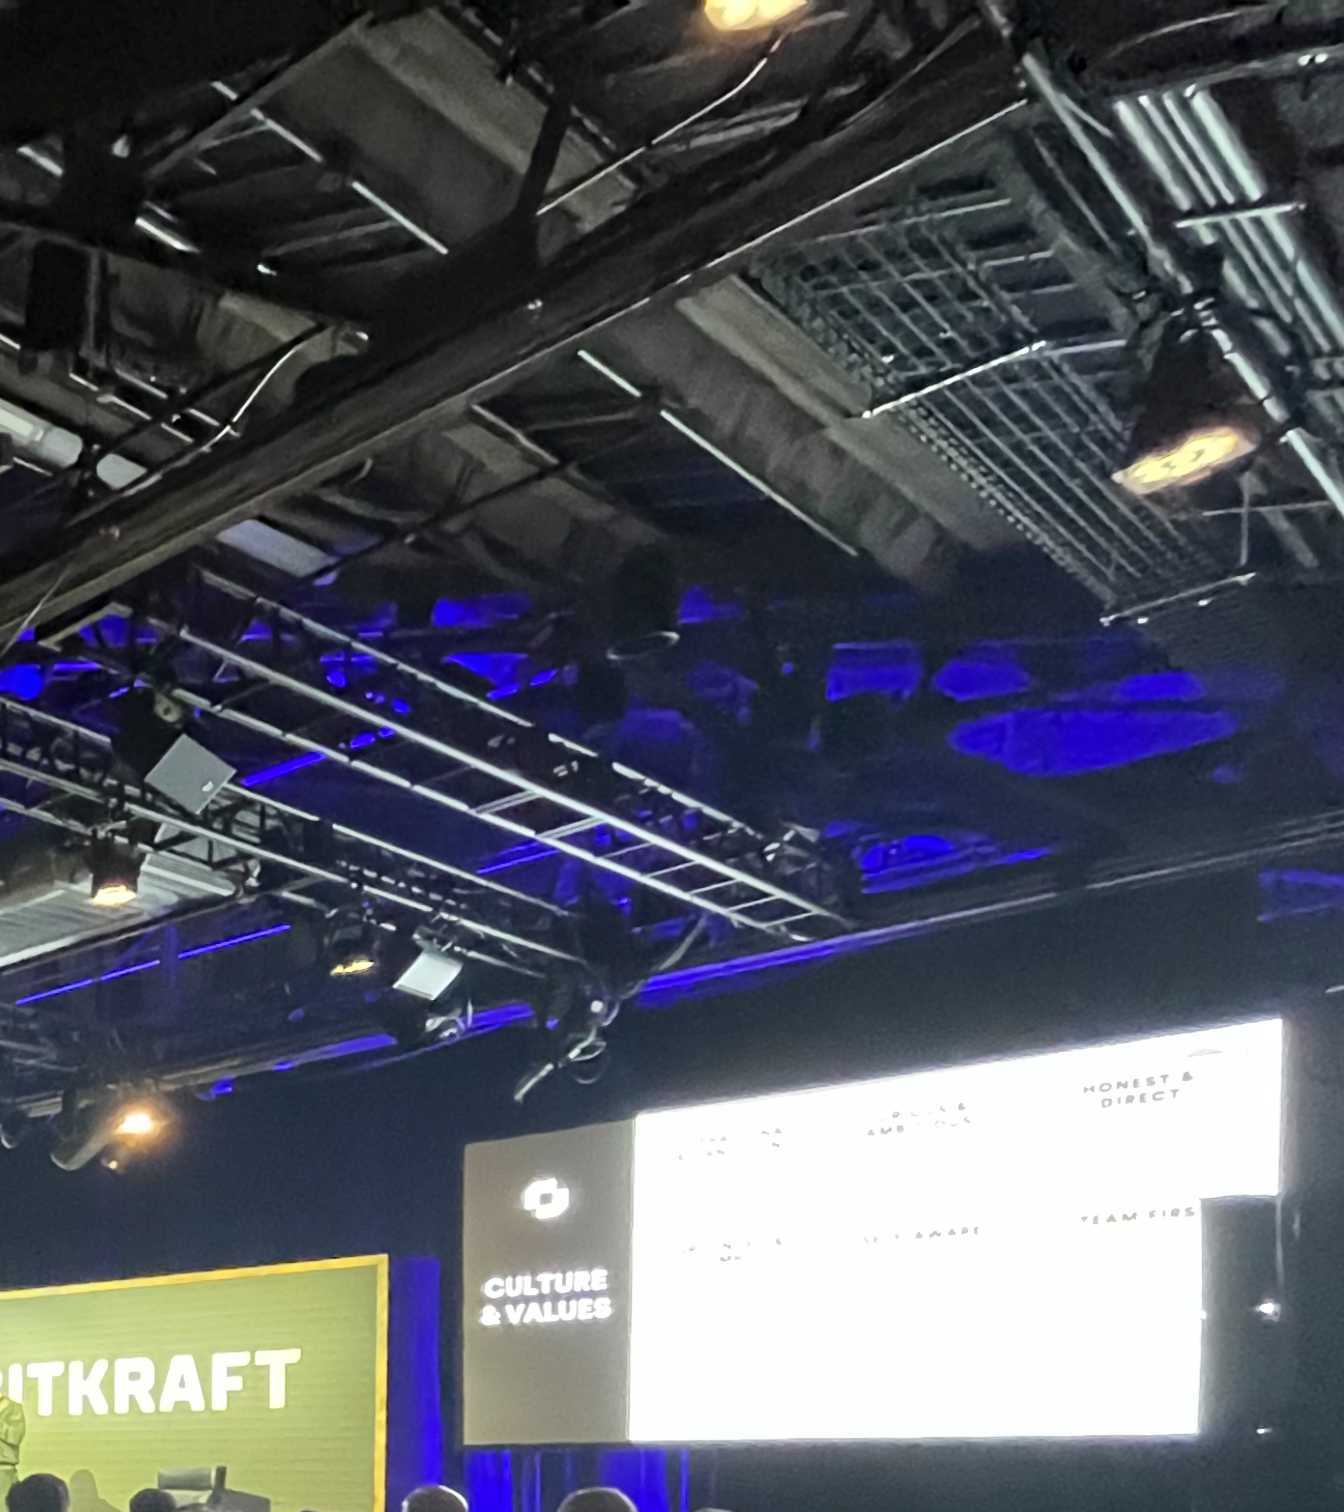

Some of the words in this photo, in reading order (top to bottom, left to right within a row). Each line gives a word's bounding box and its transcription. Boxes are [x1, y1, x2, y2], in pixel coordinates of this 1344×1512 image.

[1083, 1073, 1169, 1094] HONEST
[1100, 1088, 1180, 1109] DIRECT
[1080, 1211, 1138, 1225] TEAM
[1148, 1207, 1196, 1220] FIRS
[483, 1268, 609, 1300] CULTURE
[480, 1304, 502, 1327] &
[505, 1297, 613, 1326] VALUES
